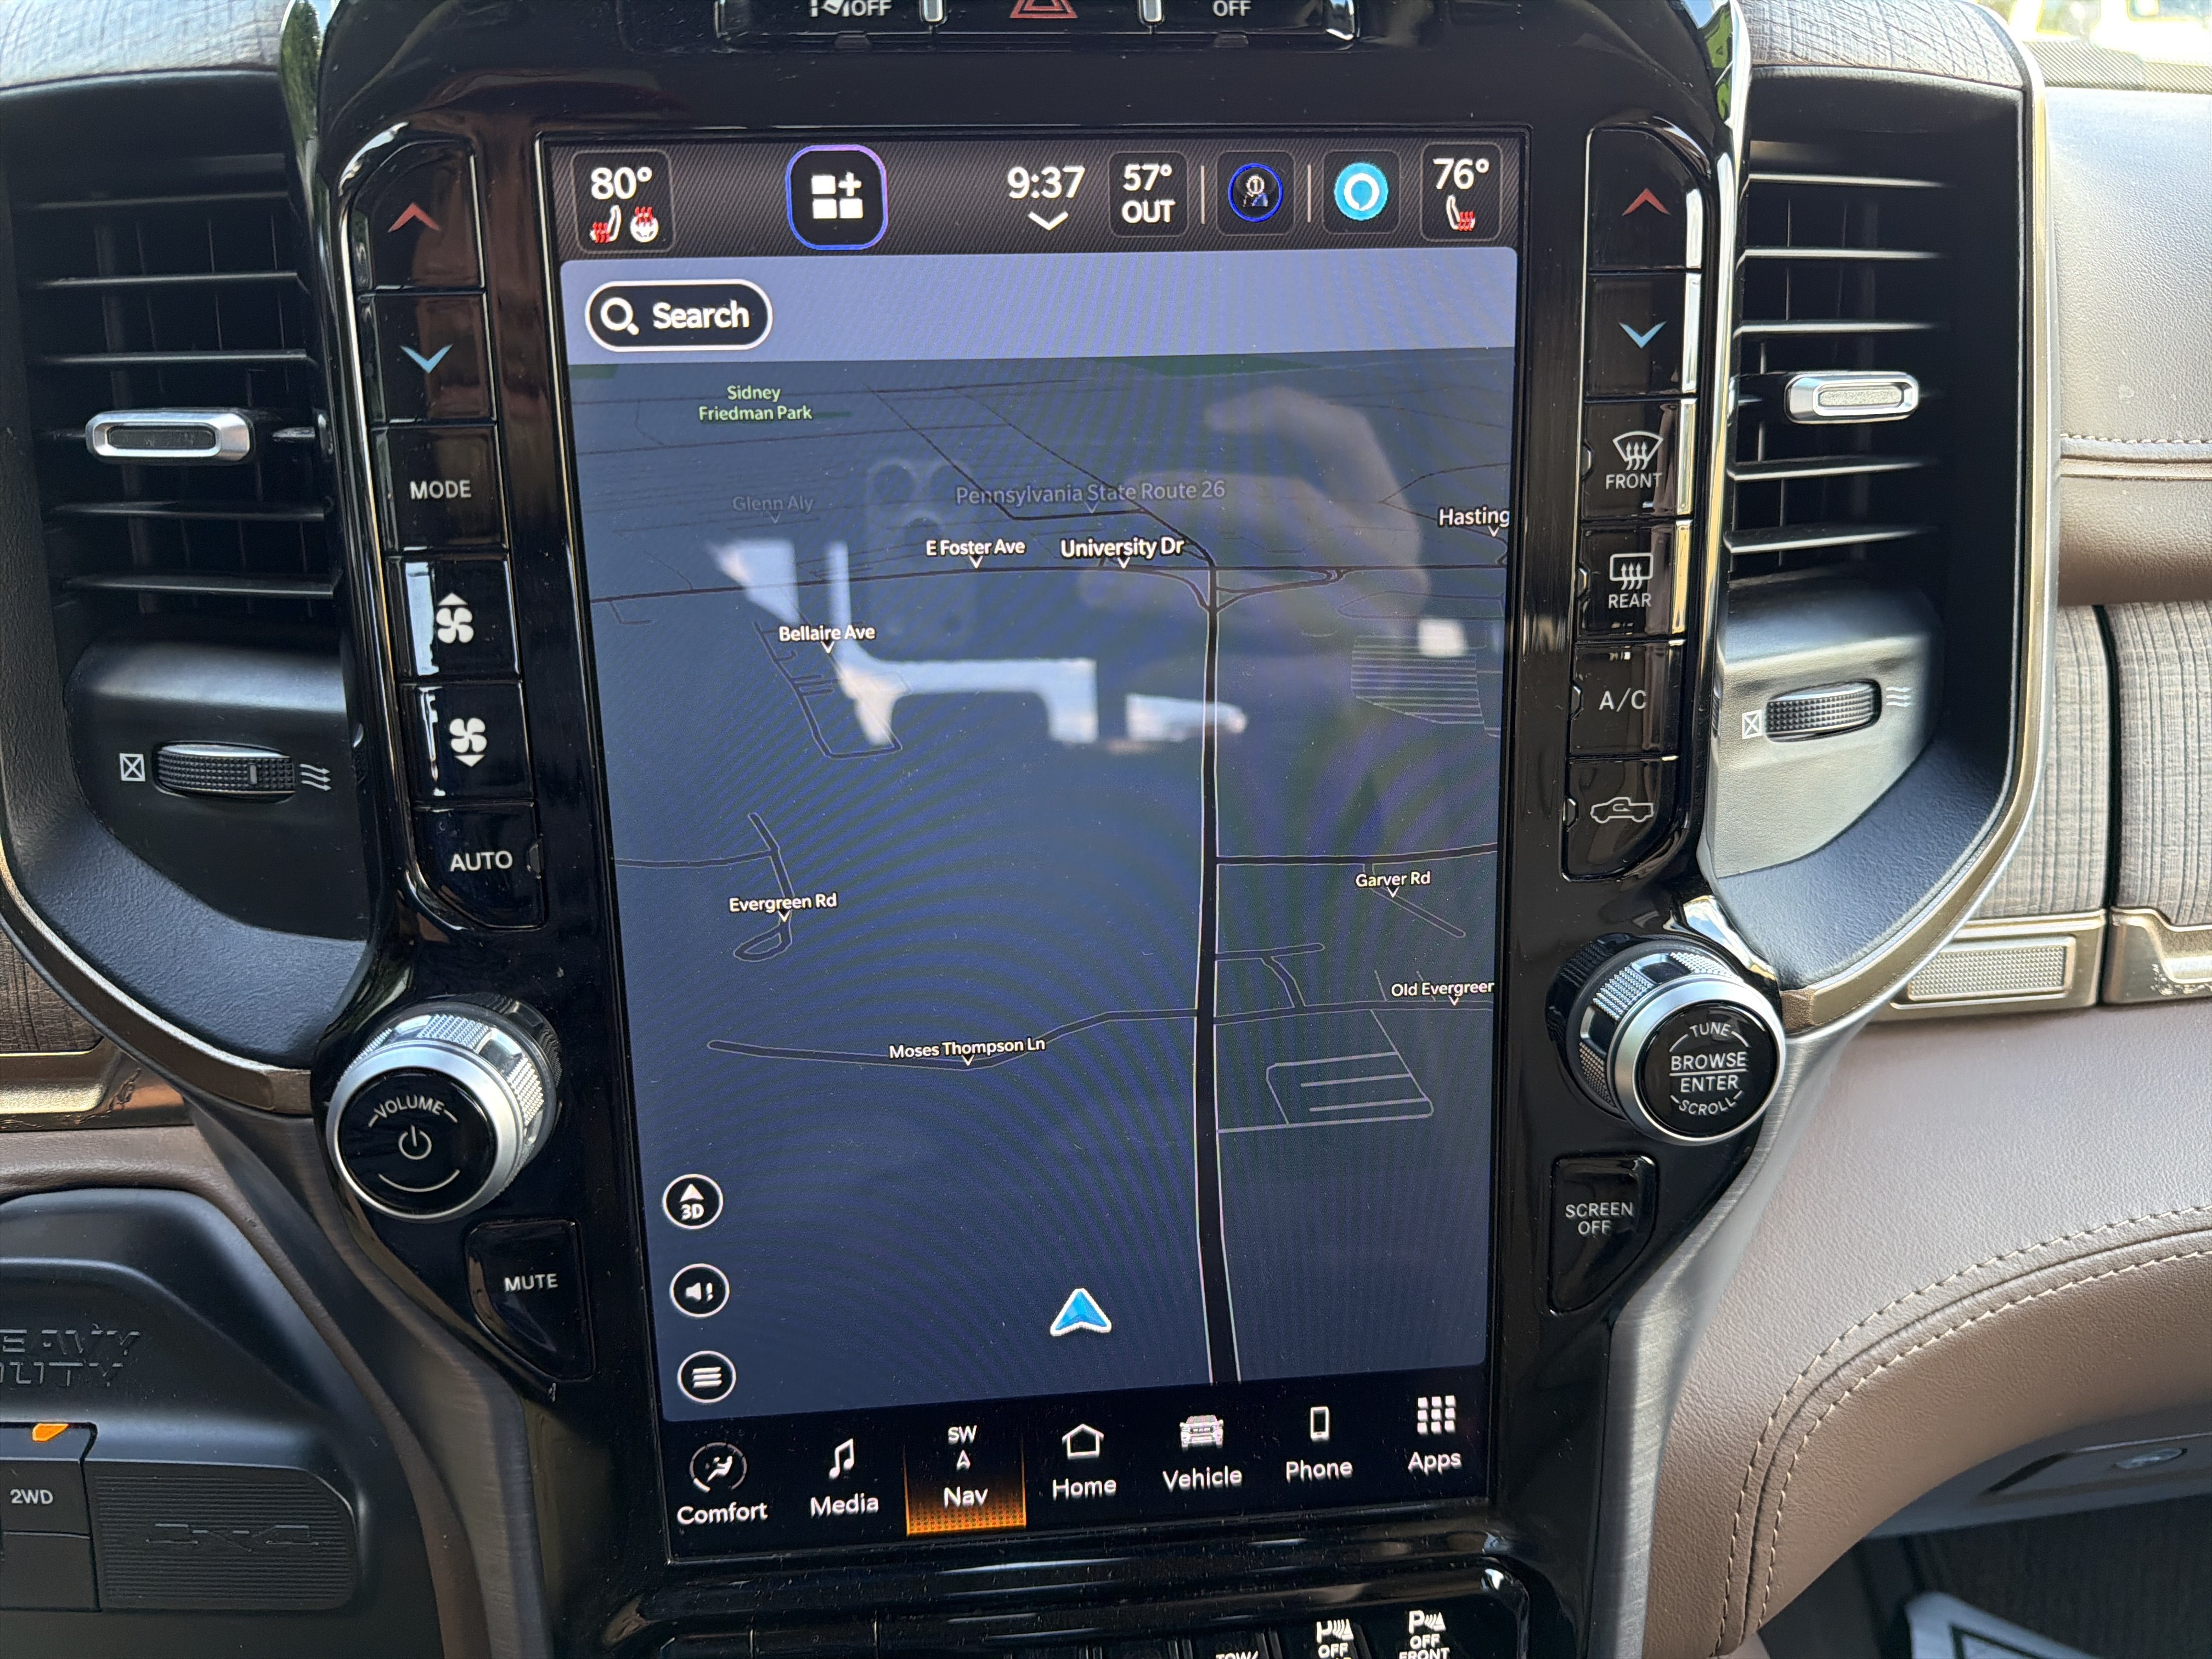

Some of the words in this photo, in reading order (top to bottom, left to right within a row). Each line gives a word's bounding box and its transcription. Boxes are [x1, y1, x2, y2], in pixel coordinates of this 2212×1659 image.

[851, 0, 892, 16] OFF
[1213, 0, 1251, 16] OFF
[1007, 166, 1085, 198] 9:37
[1122, 200, 1175, 223] OUT
[653, 300, 750, 329] Search
[727, 385, 781, 403] Sidney
[698, 405, 774, 421] Friedman
[777, 405, 812, 420] Park
[410, 481, 472, 500] MODE
[1605, 473, 1662, 490] FRONT
[956, 485, 1082, 506] Pennsylvania
[1087, 483, 1137, 501] State
[1141, 483, 1197, 500] Route
[1201, 480, 1226, 499] 26
[732, 495, 783, 511] Glenn
[1440, 506, 1510, 528] Hasting
[926, 541, 935, 556] E
[940, 540, 991, 555] Foster
[994, 540, 1025, 555] Ave
[1060, 538, 1157, 558] University
[1161, 538, 1185, 553] Dr
[1608, 594, 1651, 609] REAR
[779, 625, 842, 642] Bellaire
[844, 625, 876, 641] Ave
[1599, 687, 1647, 711] A/C
[450, 850, 514, 871] AUTO
[1356, 873, 1407, 888] Garver
[1410, 871, 1431, 884] Rd
[730, 896, 811, 912] Evergreen
[815, 893, 838, 907] Rd
[1391, 983, 1418, 996] Old
[1690, 1022, 1731, 1037] TUNE
[889, 1046, 940, 1059] Moses
[942, 1041, 1024, 1058] Thompson
[1027, 1038, 1045, 1051] Ln
[1671, 1052, 1748, 1071] BROWSE
[1680, 1075, 1739, 1093] ENTER
[374, 1095, 443, 1119] VOLUME
[1679, 1097, 1736, 1116] SCROLL
[681, 1203, 704, 1220] 3D
[1565, 1202, 1633, 1218] SCREEN
[1578, 1221, 1611, 1235] OFF
[504, 1273, 558, 1291] MUTE
[0, 1362, 123, 1387] UTY
[948, 1425, 977, 1443] SW
[1286, 1460, 1353, 1483] Phone
[1408, 1452, 1462, 1474] Apps
[1163, 1466, 1243, 1491] Vehicle
[10, 1489, 53, 1505] 2WD
[944, 1486, 988, 1508] Nav
[1052, 1477, 1116, 1500] Home
[677, 1502, 768, 1525] Comfort
[810, 1493, 879, 1518] Media
[1318, 1643, 1348, 1658] OFF
[1410, 1634, 1440, 1649] OFF
